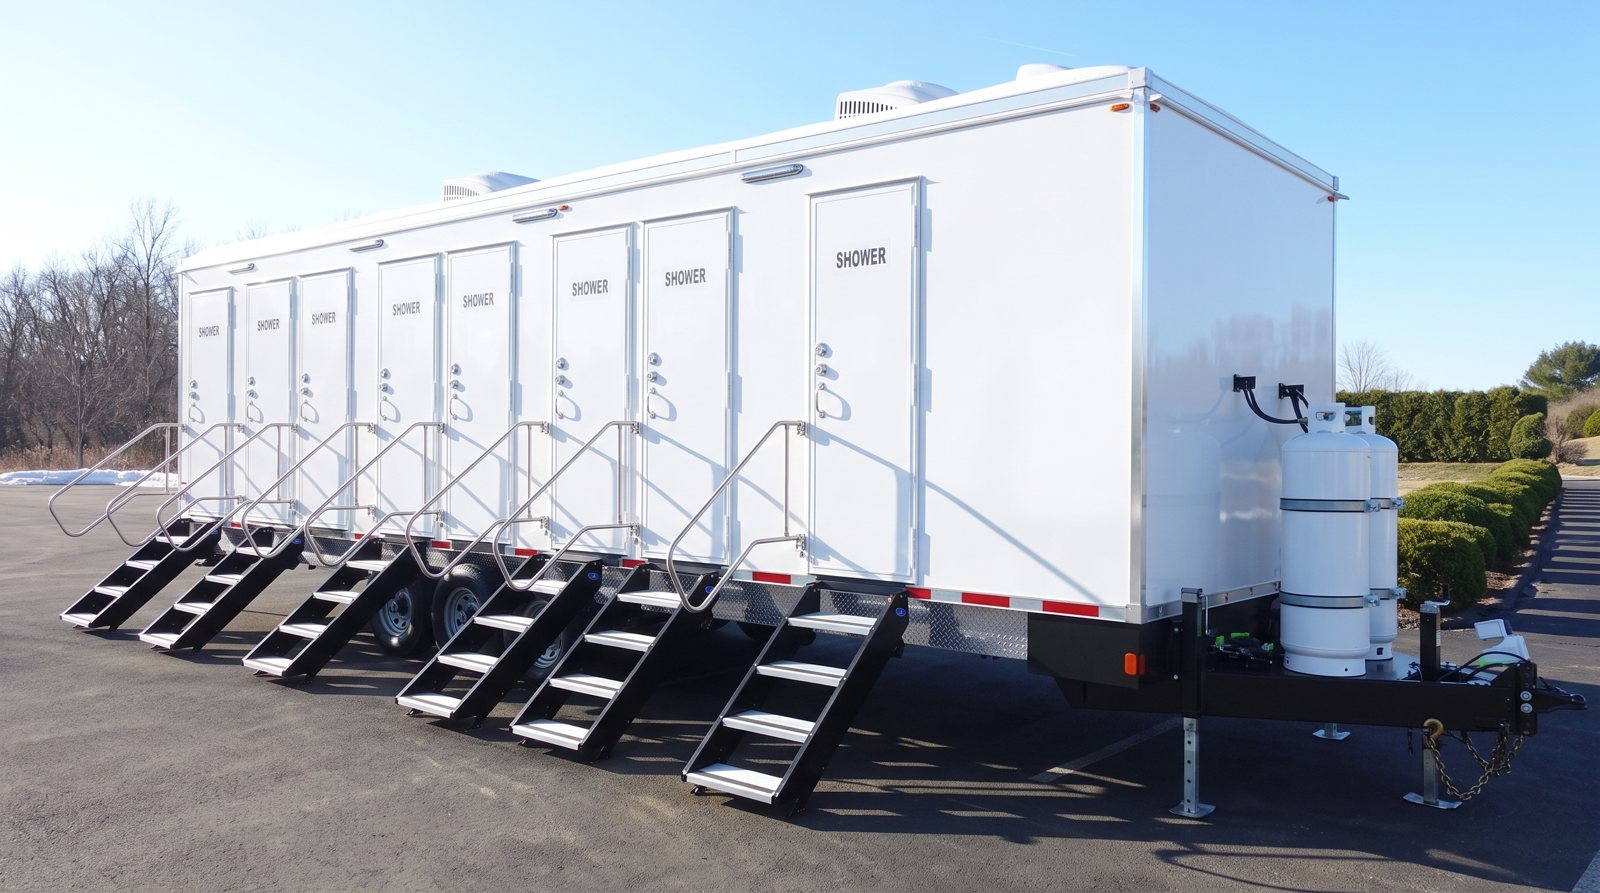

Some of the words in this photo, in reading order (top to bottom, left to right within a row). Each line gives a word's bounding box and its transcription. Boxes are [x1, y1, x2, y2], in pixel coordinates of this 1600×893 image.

[836, 247, 887, 269] SHOWER
[665, 268, 706, 287] SHOWER
[572, 279, 609, 297] SHOWER
[463, 293, 494, 309] SHOWER
[392, 302, 421, 316] SHOWER
[257, 319, 280, 332] SHOWER
[311, 312, 336, 326] SHOWER
[199, 325, 220, 338] SHOWER
